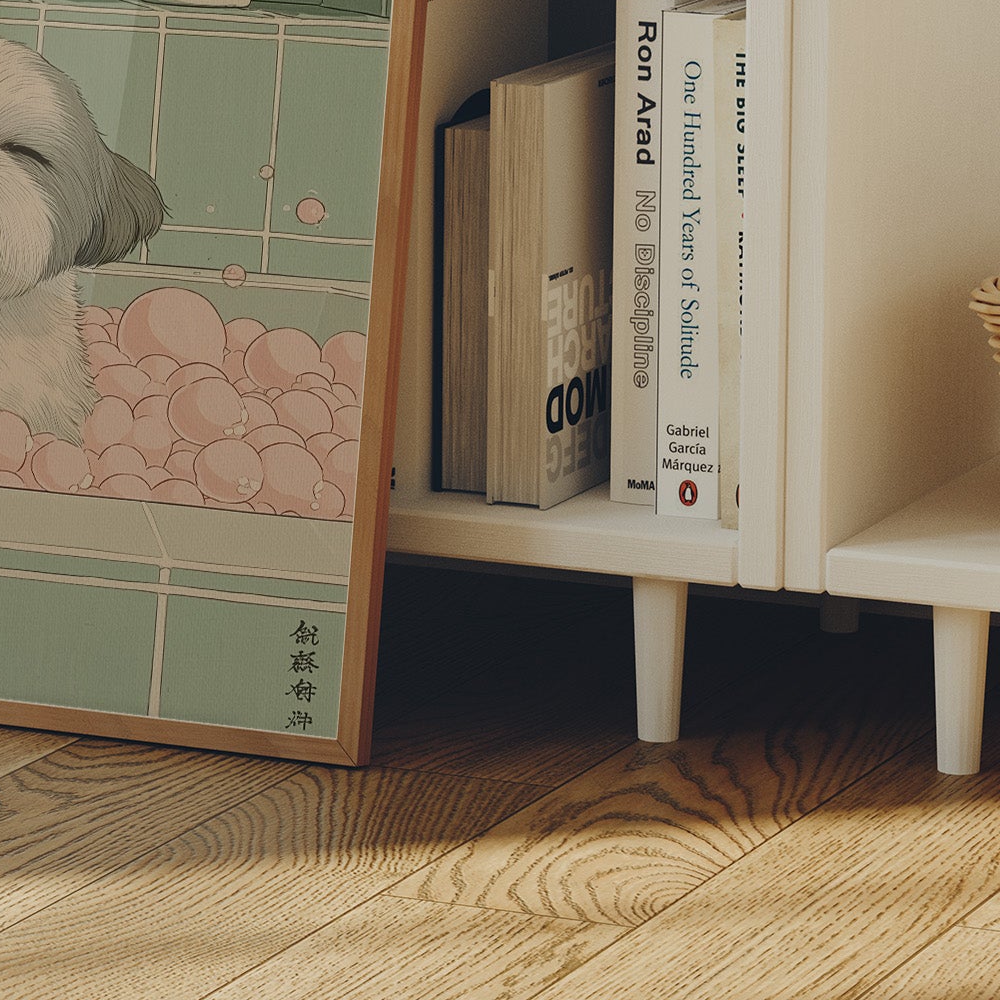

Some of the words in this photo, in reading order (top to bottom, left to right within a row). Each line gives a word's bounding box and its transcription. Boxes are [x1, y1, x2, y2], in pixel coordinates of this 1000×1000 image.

[637, 21, 657, 82] Ron
[684, 61, 702, 104] One
[636, 92, 657, 165] Arad
[682, 112, 702, 200] Hundred
[635, 190, 656, 232] No
[681, 207, 701, 261] Years
[681, 268, 700, 292] of
[630, 243, 656, 389] Discipline
[680, 298, 700, 379] Solitude
[546, 364, 607, 434] MOD
[666, 424, 710, 438] Gabriel
[668, 441, 706, 455] García
[627, 478, 656, 491] MoMA
[662, 458, 714, 474] Márquez
